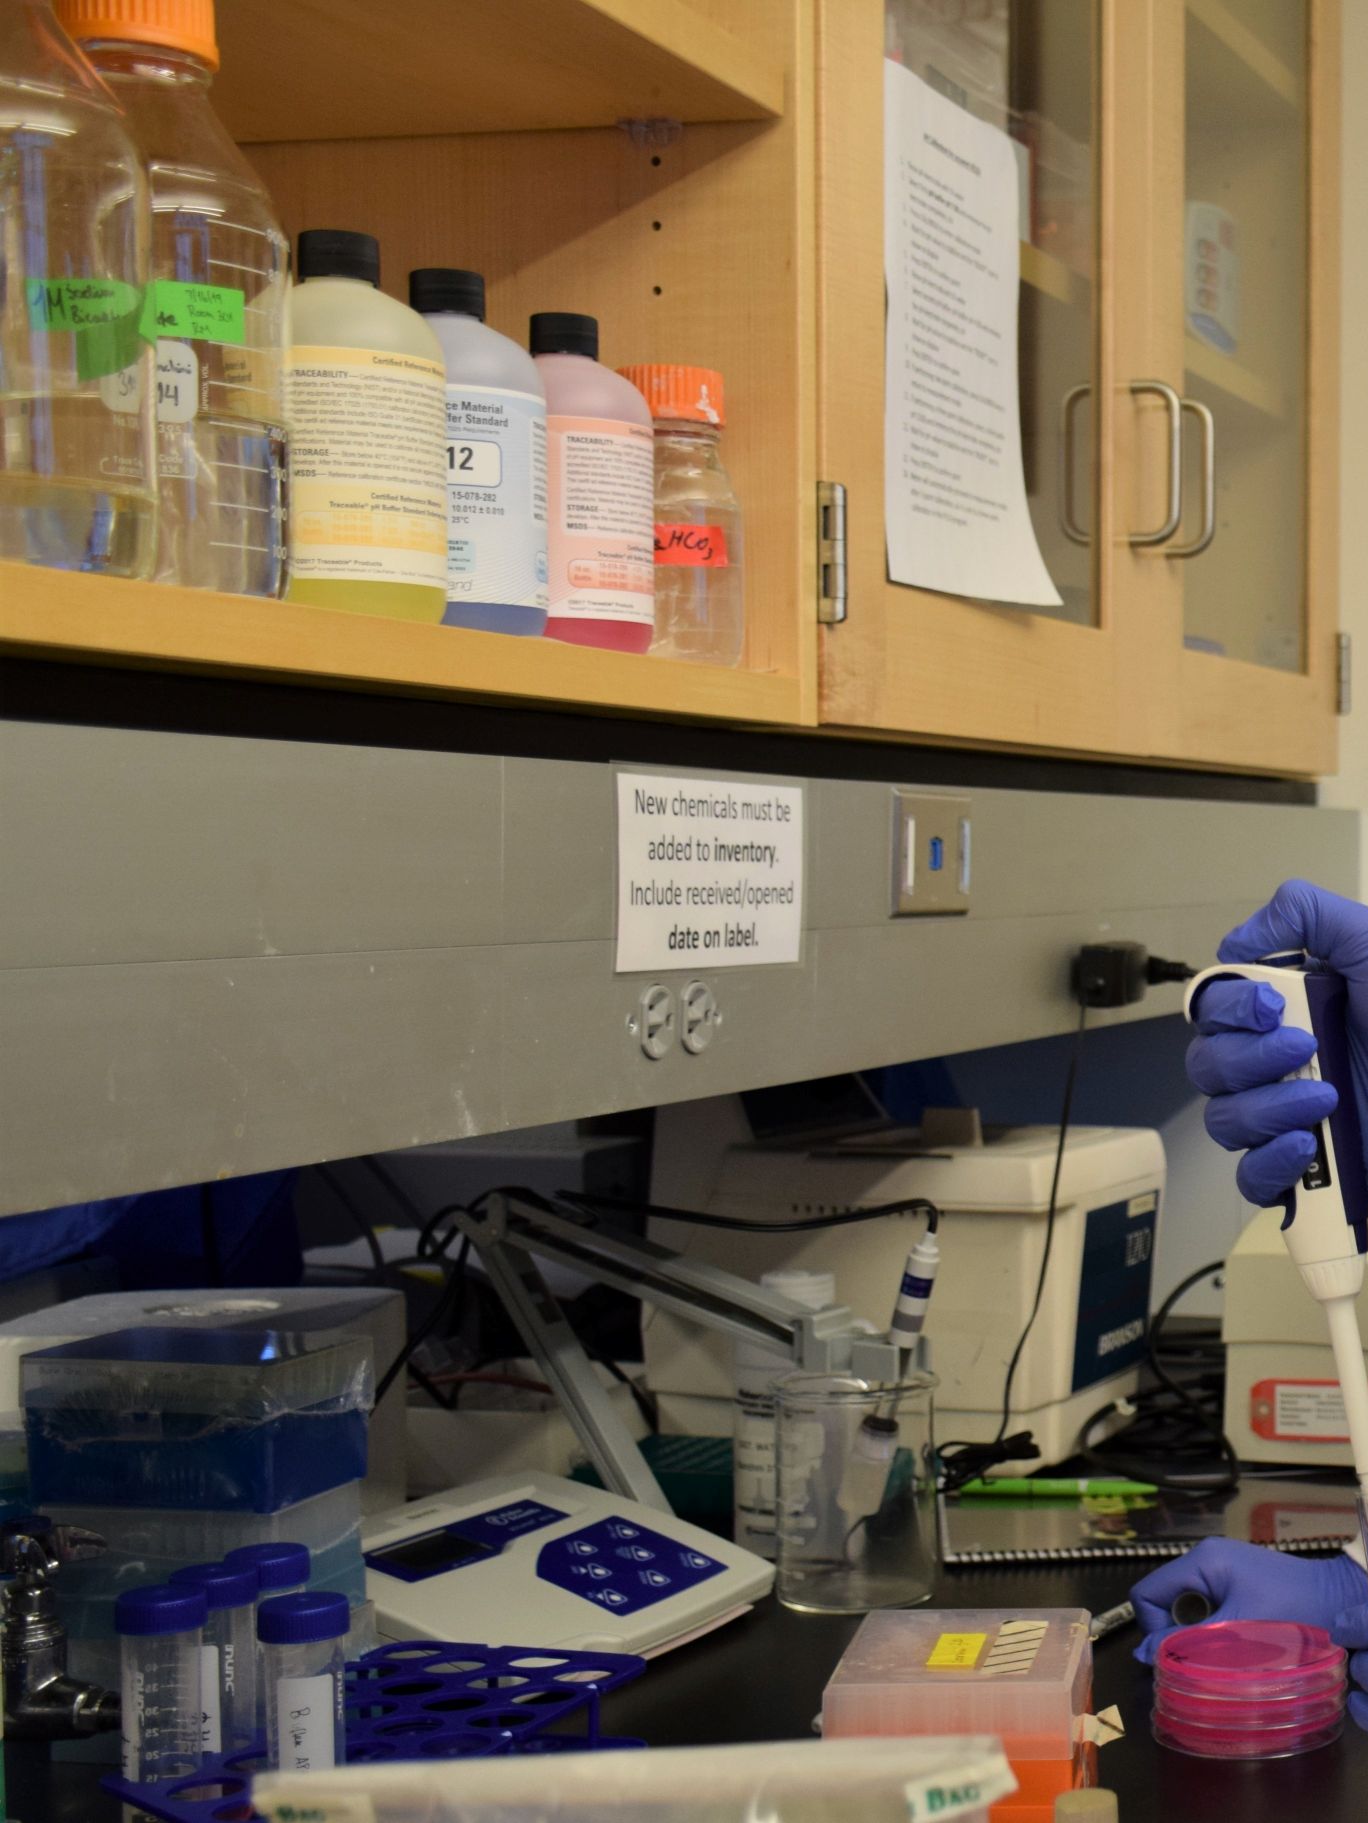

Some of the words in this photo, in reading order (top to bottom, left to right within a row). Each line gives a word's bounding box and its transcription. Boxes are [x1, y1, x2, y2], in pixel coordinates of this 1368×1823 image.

[461, 401, 503, 414] Material
[466, 414, 509, 427] Standard
[635, 788, 668, 815] New
[672, 790, 738, 820] chemicals
[742, 798, 772, 821] must
[776, 796, 791, 822] be
[648, 834, 692, 861] added
[696, 838, 710, 862] to
[714, 837, 779, 869] inventory.
[630, 879, 682, 906] Include
[686, 878, 794, 911] received/opened
[668, 924, 700, 950] date
[703, 929, 721, 949] on
[724, 922, 759, 948] label.
[224, 1643, 234, 1692] nunc
